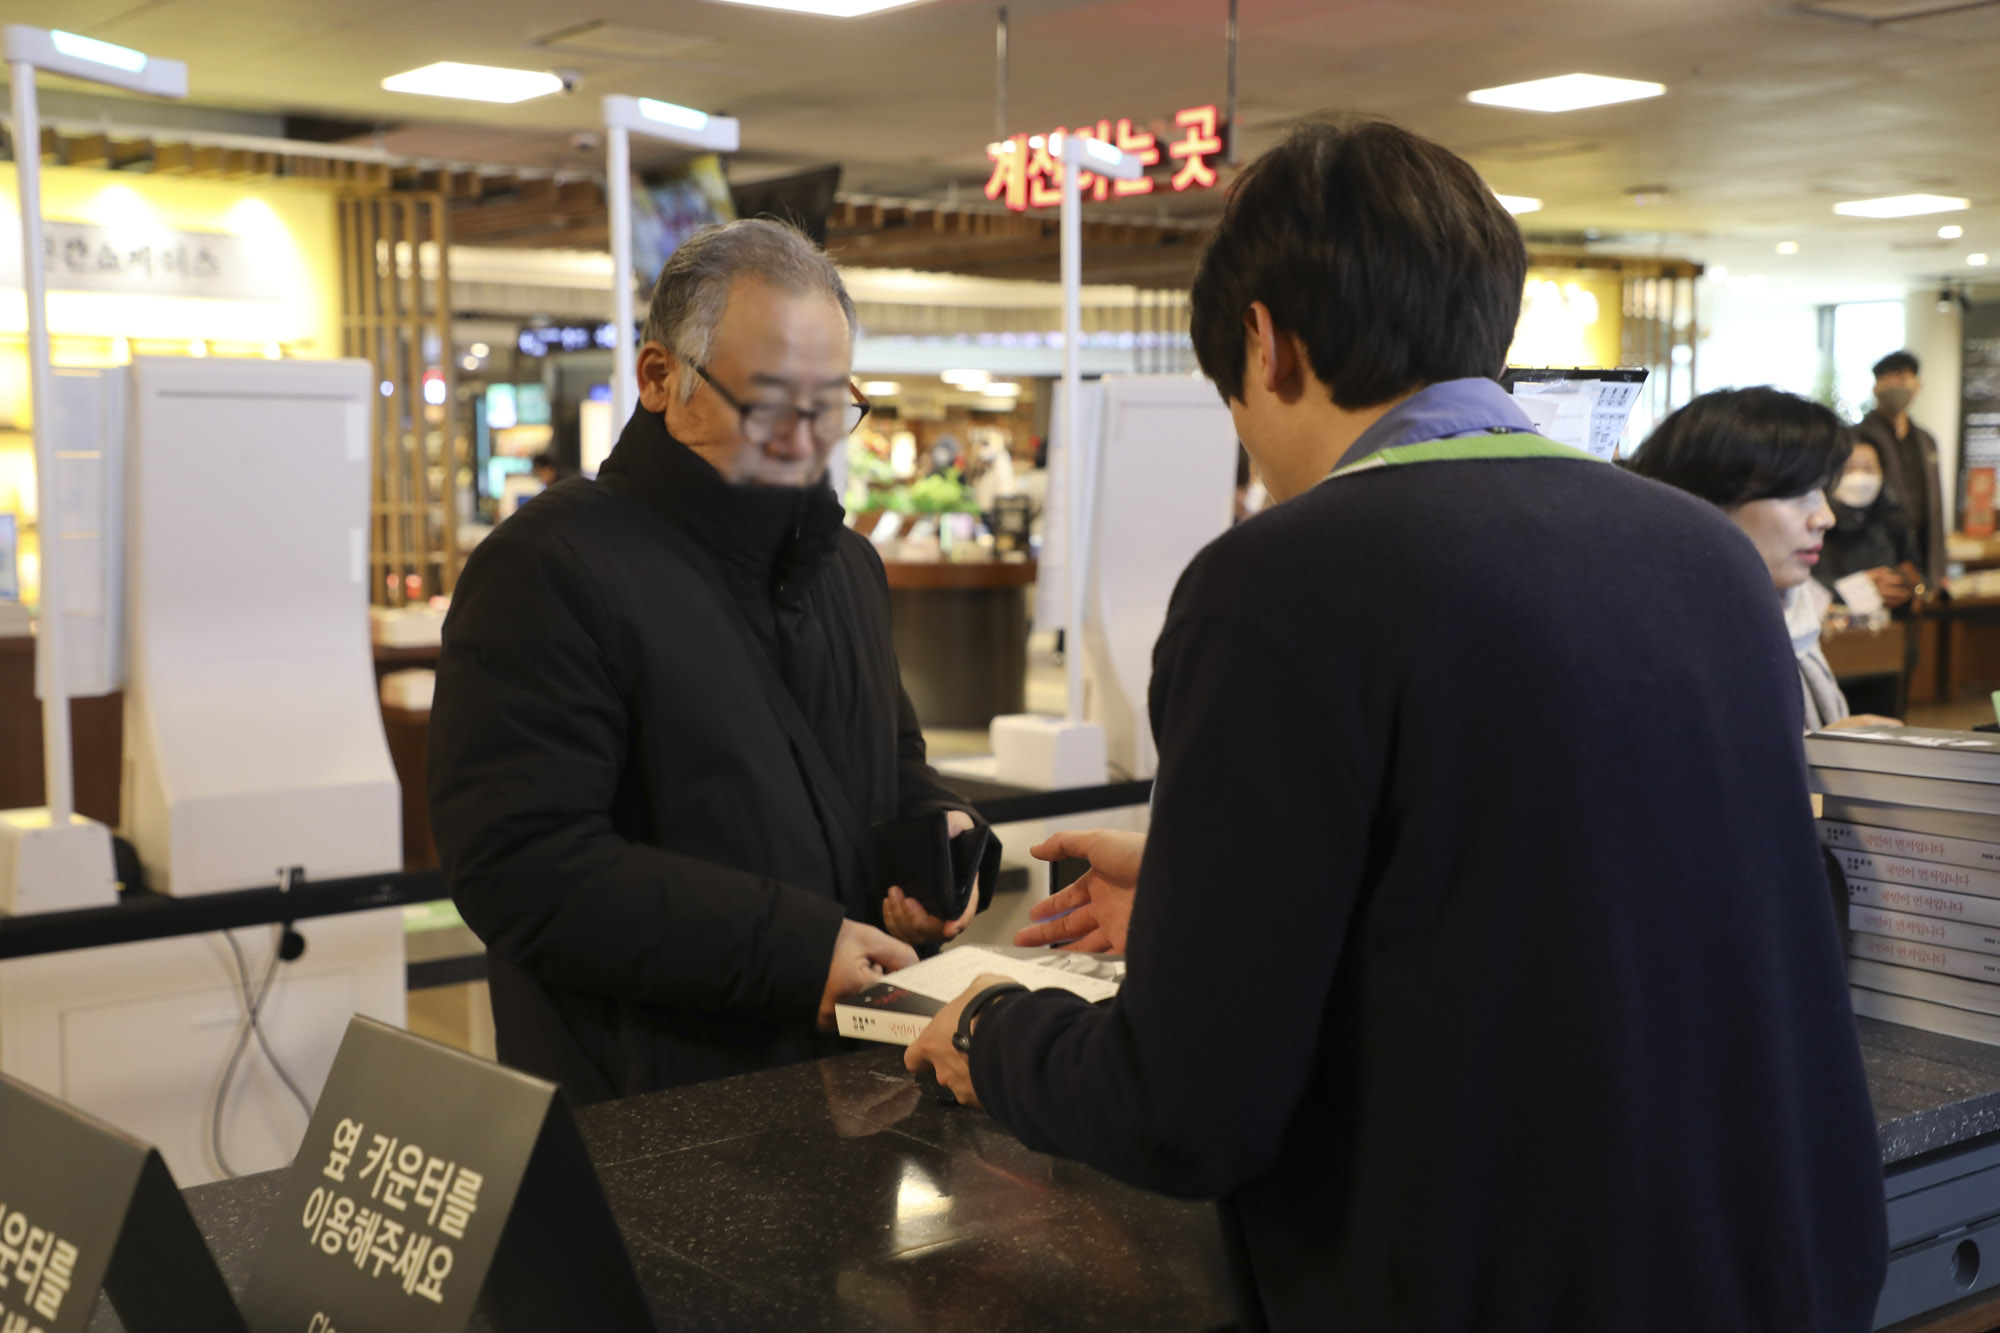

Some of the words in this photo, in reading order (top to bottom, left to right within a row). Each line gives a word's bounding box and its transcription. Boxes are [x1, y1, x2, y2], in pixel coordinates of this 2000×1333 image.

[1169, 104, 1222, 192] 곳
[1895, 838, 1945, 856] 먼저입니다
[1913, 893, 1964, 914] 먼저입니다
[1918, 868, 1970, 888] 먼저입니다
[1895, 920, 1945, 939] 먼저입니다
[323, 1118, 364, 1182] 옆
[359, 1133, 483, 1240] 카운터를
[0, 1203, 79, 1322] 운터를
[303, 1187, 453, 1304] 이용해주세요
